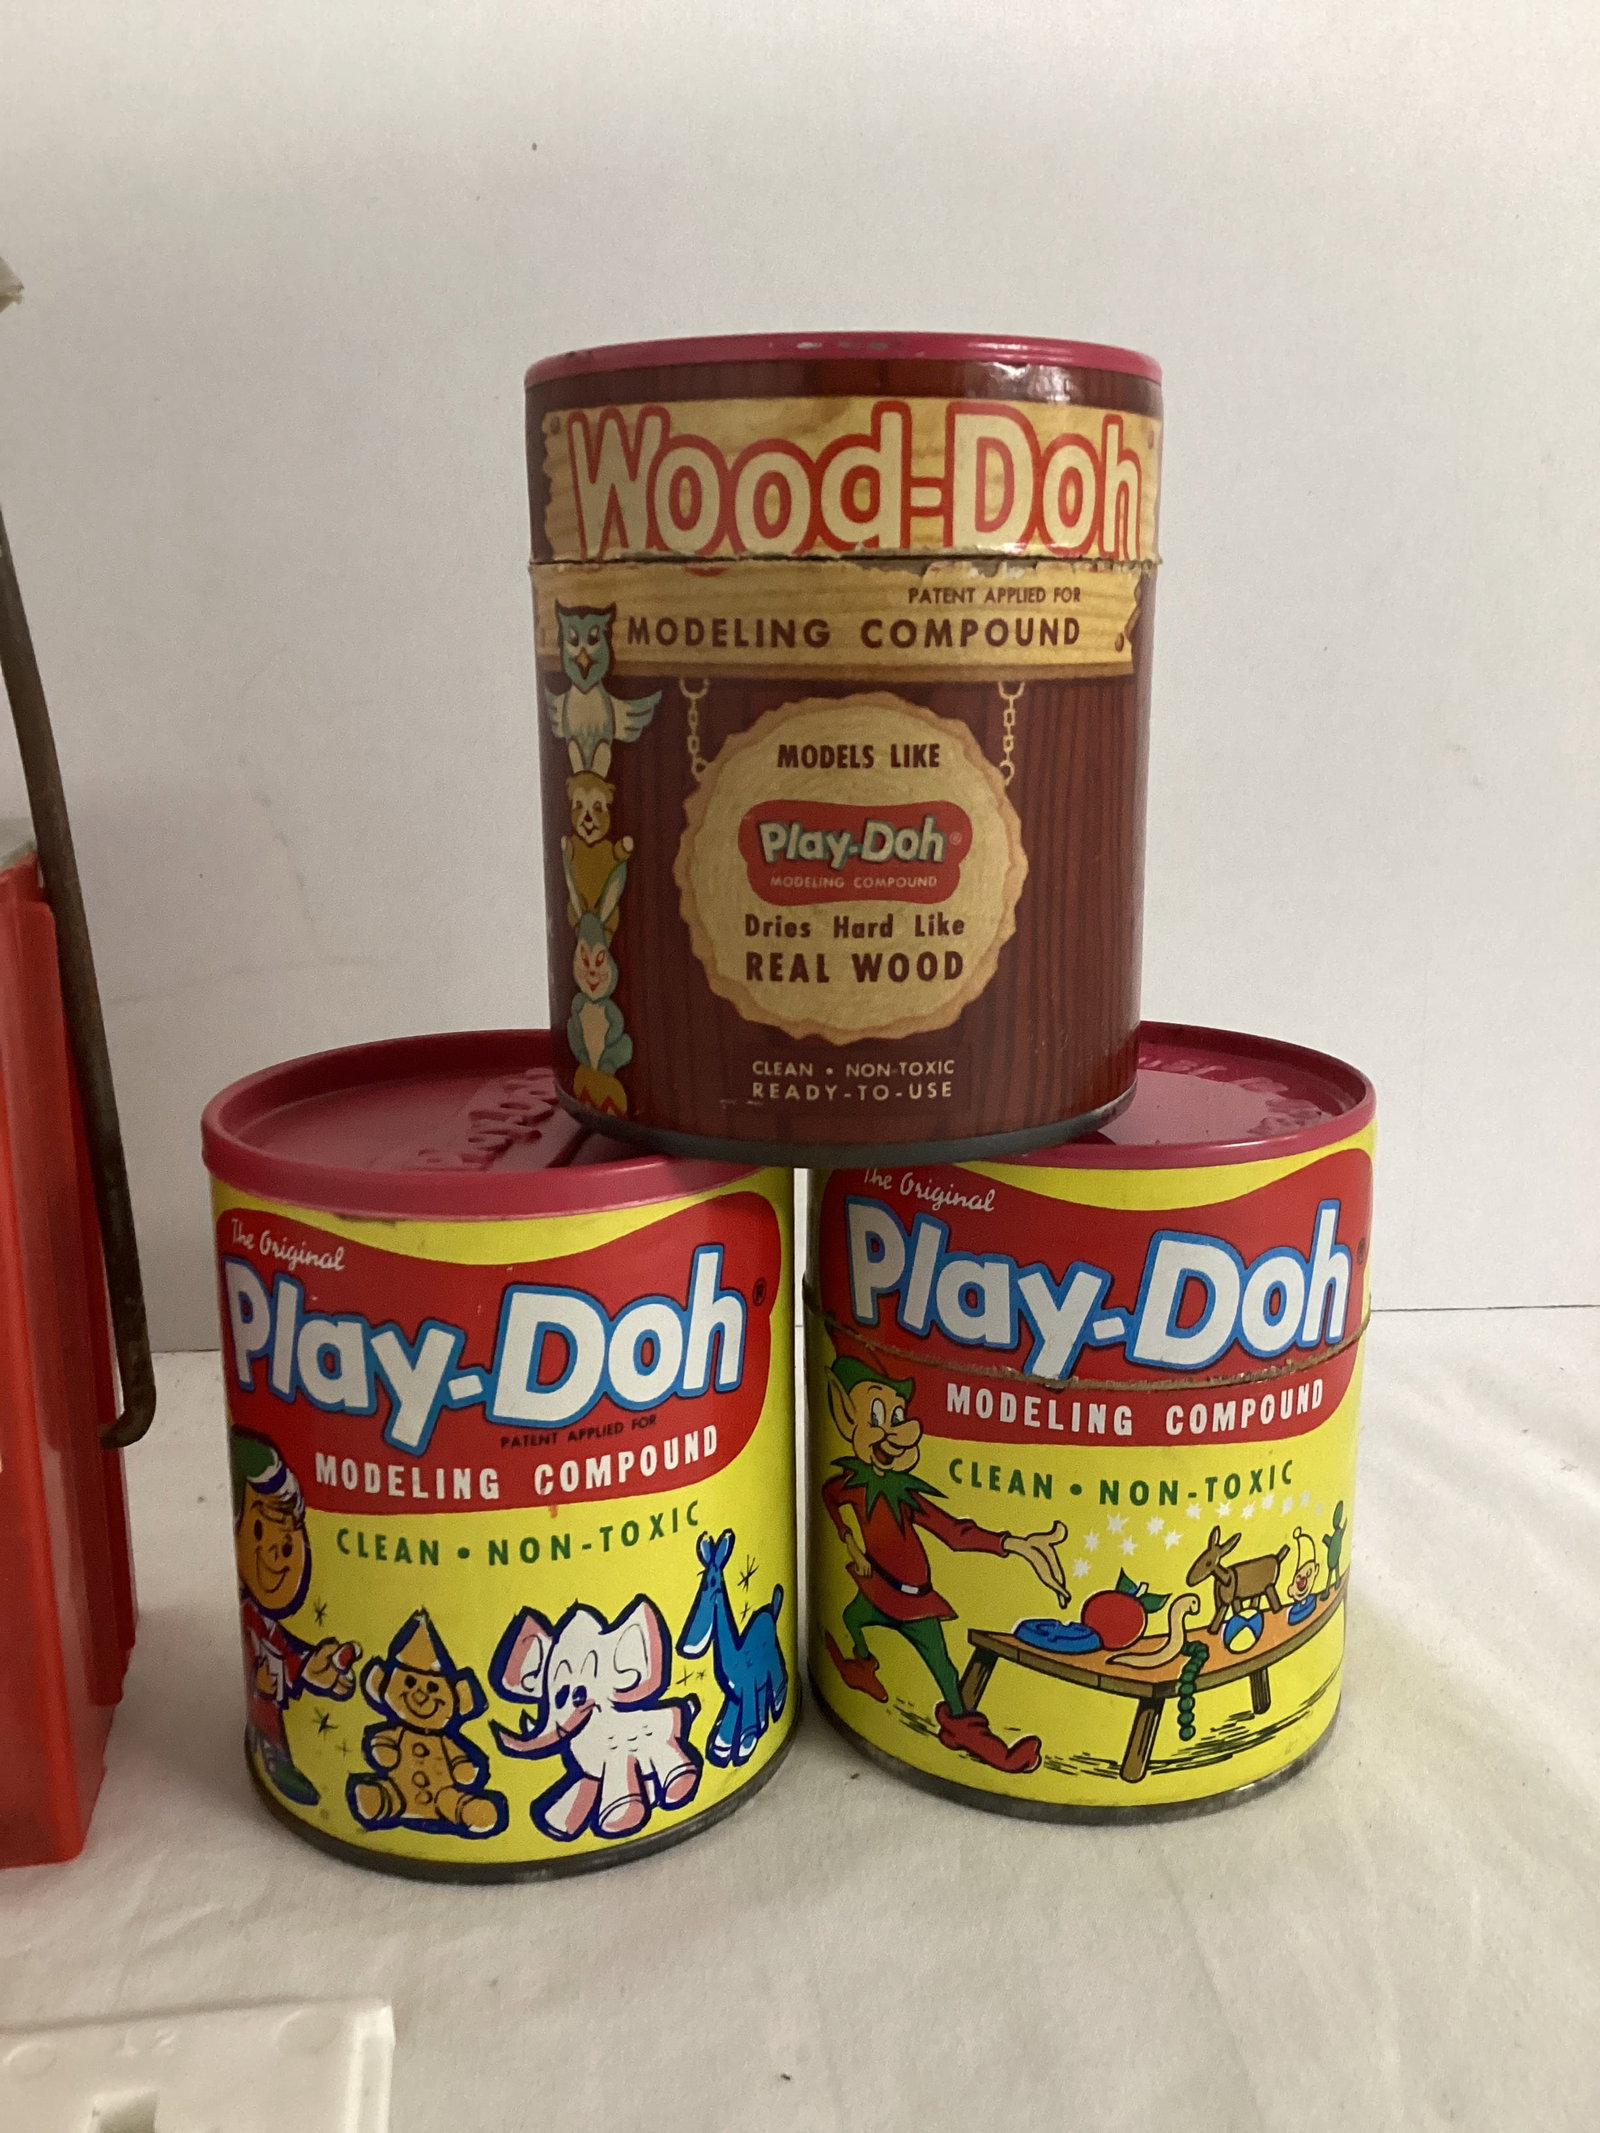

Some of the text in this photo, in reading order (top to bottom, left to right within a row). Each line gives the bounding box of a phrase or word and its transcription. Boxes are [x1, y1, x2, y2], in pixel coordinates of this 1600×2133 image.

[567, 400, 1142, 564] Wood-Doh
[908, 585, 1081, 605] PATENT APPLIED FOR
[627, 615, 1081, 649] MODELING COMPOUND
[777, 743, 940, 769] MODELS LIKE
[757, 813, 946, 870] Play-Doh
[770, 875, 938, 889] MODELING COMPOUND
[745, 912, 965, 939] Dries Hard Like
[746, 950, 964, 983] REAL WOOD
[752, 1059, 955, 1078] CLEAN NON-TOXIC
[753, 1081, 952, 1101] READY-TO-USE
[900, 1172, 996, 1212] Original
[231, 1218, 345, 1271] The Original
[845, 1197, 1351, 1381] Play-Doh
[221, 1243, 749, 1457] Play-Doh
[946, 1378, 1324, 1436] MODELING COMPOUND
[501, 1414, 657, 1448] PATENT APPLIED FOR
[314, 1424, 718, 1500] MODELING COMPOUND
[948, 1457, 1295, 1507] CLEAN NON-TOXIC
[336, 1500, 700, 1568] CLEAN NON-TOXIC
